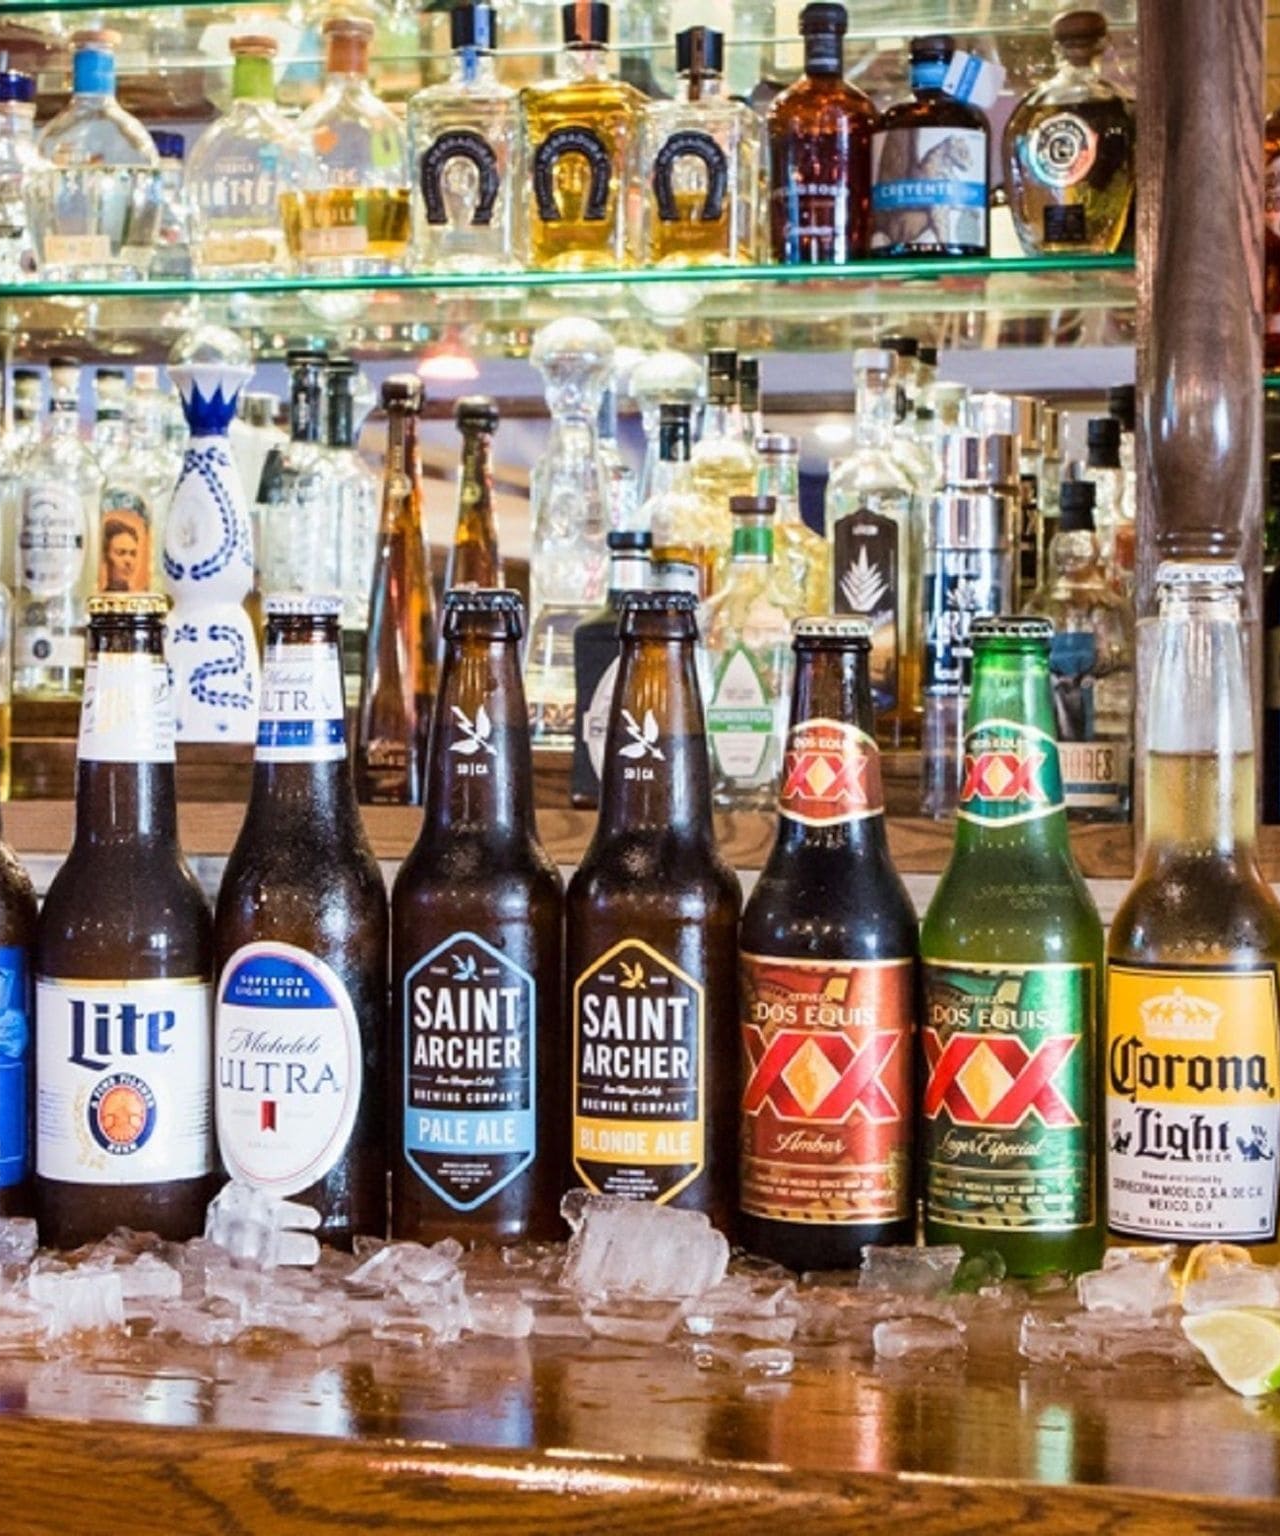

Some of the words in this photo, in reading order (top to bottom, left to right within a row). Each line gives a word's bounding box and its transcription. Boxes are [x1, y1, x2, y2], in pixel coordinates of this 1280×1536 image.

[274, 987, 312, 999] BEER
[413, 985, 521, 1033] SAINT
[581, 993, 690, 1042] SAINT
[756, 1002, 798, 1022] DOS
[804, 1005, 876, 1026] EQUIS
[933, 1006, 971, 1027] DOS
[978, 1010, 1051, 1029] EQUIS
[67, 999, 176, 1072] Lite
[227, 1026, 322, 1054] Michelob
[413, 1035, 521, 1070] ARCHER
[581, 1043, 690, 1080] ARCHER
[219, 1056, 344, 1095] ULTRA
[1109, 1033, 1270, 1103] Corona
[413, 1088, 462, 1105] BREWING
[581, 1098, 628, 1113] BREWING
[631, 1099, 689, 1114] COMPANY
[418, 1117, 470, 1146] PALE
[474, 1118, 517, 1145] ALE
[579, 1126, 648, 1154] BLONDE
[653, 1128, 693, 1155] ALE
[775, 1128, 846, 1154] Ambar
[1134, 1106, 1230, 1162] Light
[1195, 1153, 1233, 1163] BEER
